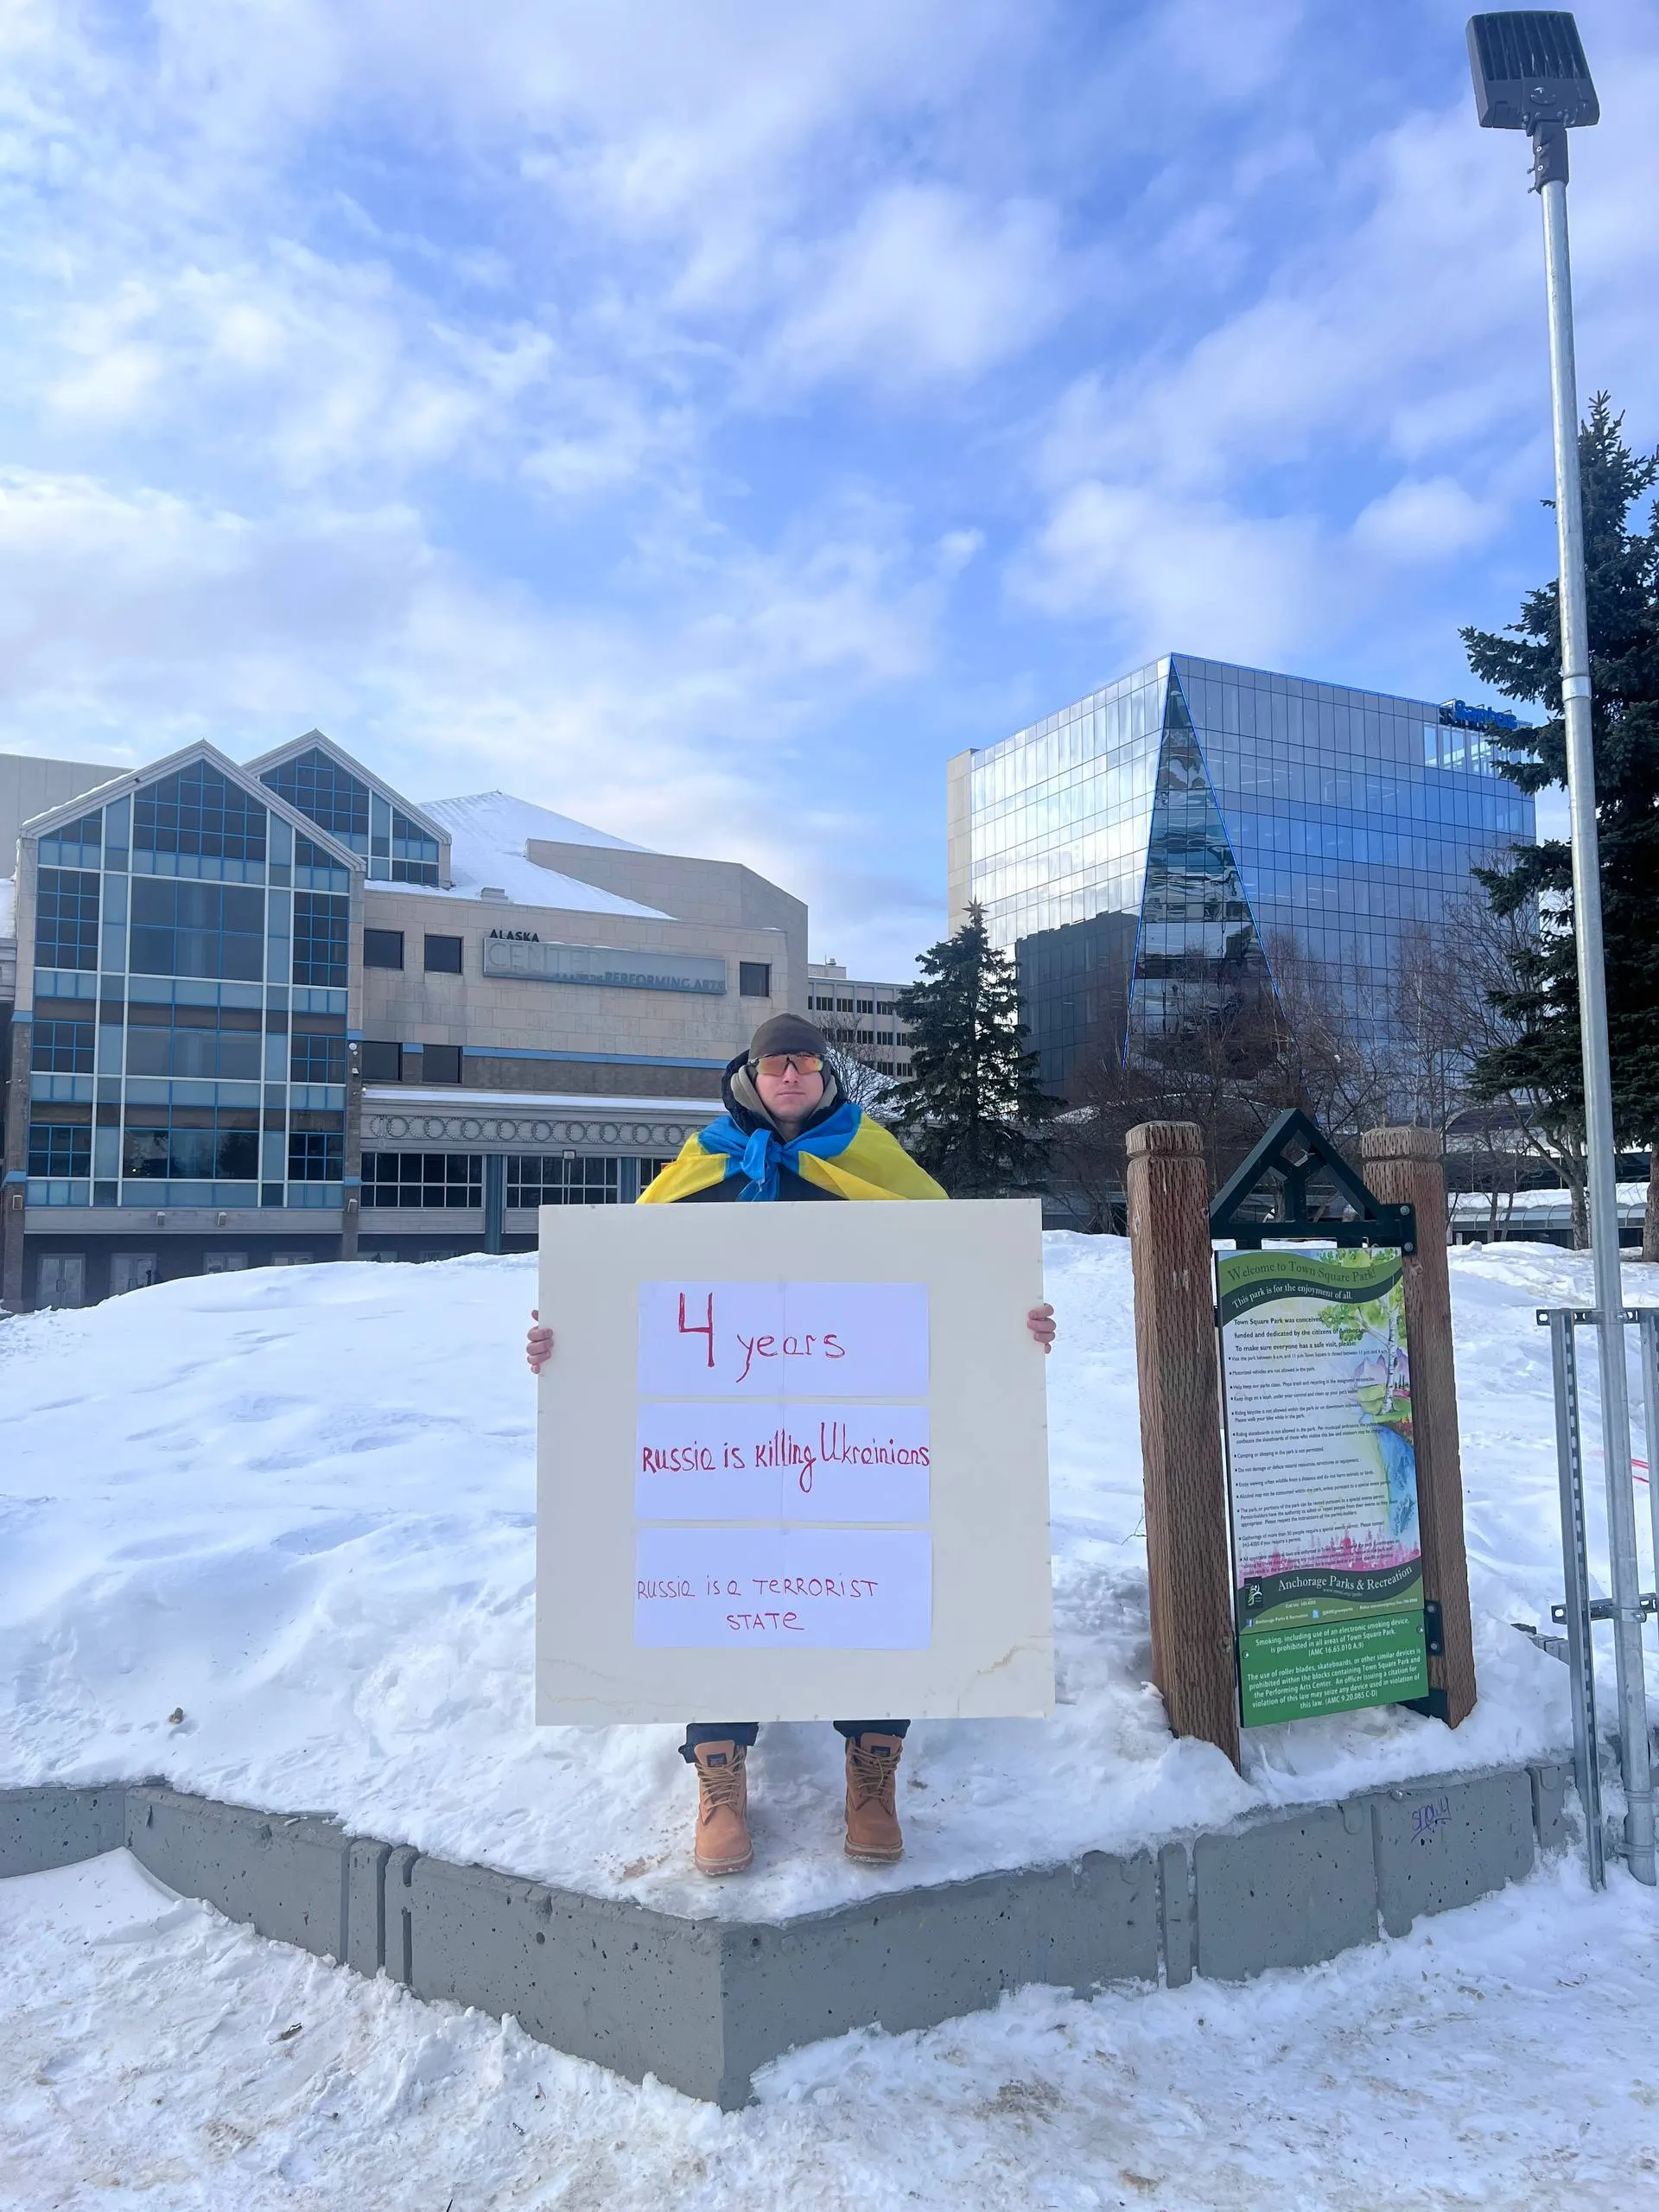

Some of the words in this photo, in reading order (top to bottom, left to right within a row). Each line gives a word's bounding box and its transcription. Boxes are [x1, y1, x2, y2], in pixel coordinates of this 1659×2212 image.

[489, 929, 540, 943] ALASKA
[488, 942, 602, 974] CENTER
[605, 970, 690, 988] PERFORMING
[1227, 1264, 1276, 1281] Welcome
[1277, 1262, 1287, 1271] to
[1288, 1261, 1315, 1276] Town
[1318, 1268, 1351, 1283] Square
[1351, 1265, 1376, 1282] Park!
[1232, 1295, 1249, 1309] This
[1249, 1287, 1265, 1302] park
[1273, 1284, 1283, 1294] for
[1285, 1283, 1296, 1292] the
[1297, 1284, 1333, 1298] enjoyment
[1335, 1290, 1342, 1299] of
[1343, 1291, 1353, 1300] all.
[1249, 1318, 1269, 1326] Square
[1294, 1329, 1300, 1338] by
[678, 1292, 715, 1368] 4
[735, 1333, 846, 1383] years
[723, 1442, 745, 1469] is
[821, 1421, 930, 1466] Ukrainians
[706, 1575, 721, 1596] is
[1279, 1576, 1327, 1592] Anchorage
[1329, 1575, 1354, 1590] Parks
[1357, 1579, 1364, 1590] &
[1367, 1566, 1413, 1591] Recreation
[1255, 1637, 1283, 1646] Smoking,
[1284, 1632, 1312, 1642] including
[1338, 1624, 1366, 1634] electronic
[1367, 1620, 1390, 1630] smoking
[1277, 1642, 1307, 1654] prohibited
[1324, 1637, 1338, 1645] areas
[1363, 1630, 1382, 1639] Square
[1279, 1668, 1294, 1676] roller
[1317, 1659, 1353, 1669] skateboards,
[1361, 1655, 1376, 1663] other
[1376, 1651, 1395, 1661] similar
[1395, 1649, 1415, 1657] devices
[1308, 1648, 1323, 1656] (AMC
[1249, 1679, 1280, 1691] prohibited
[1281, 1676, 1300, 1685] within
[1332, 1666, 1361, 1676] containing
[1378, 1660, 1397, 1669] Square
[1266, 1686, 1299, 1697] Performing
[1313, 1680, 1332, 1688] Center.
[1344, 1675, 1362, 1683] officer
[1363, 1671, 1382, 1681] issuing
[1388, 1668, 1408, 1676] citation
[1252, 1698, 1278, 1708] violation
[1351, 1682, 1368, 1691] device
[1389, 1675, 1413, 1684] violation
[1325, 1695, 1339, 1706] (AMC
